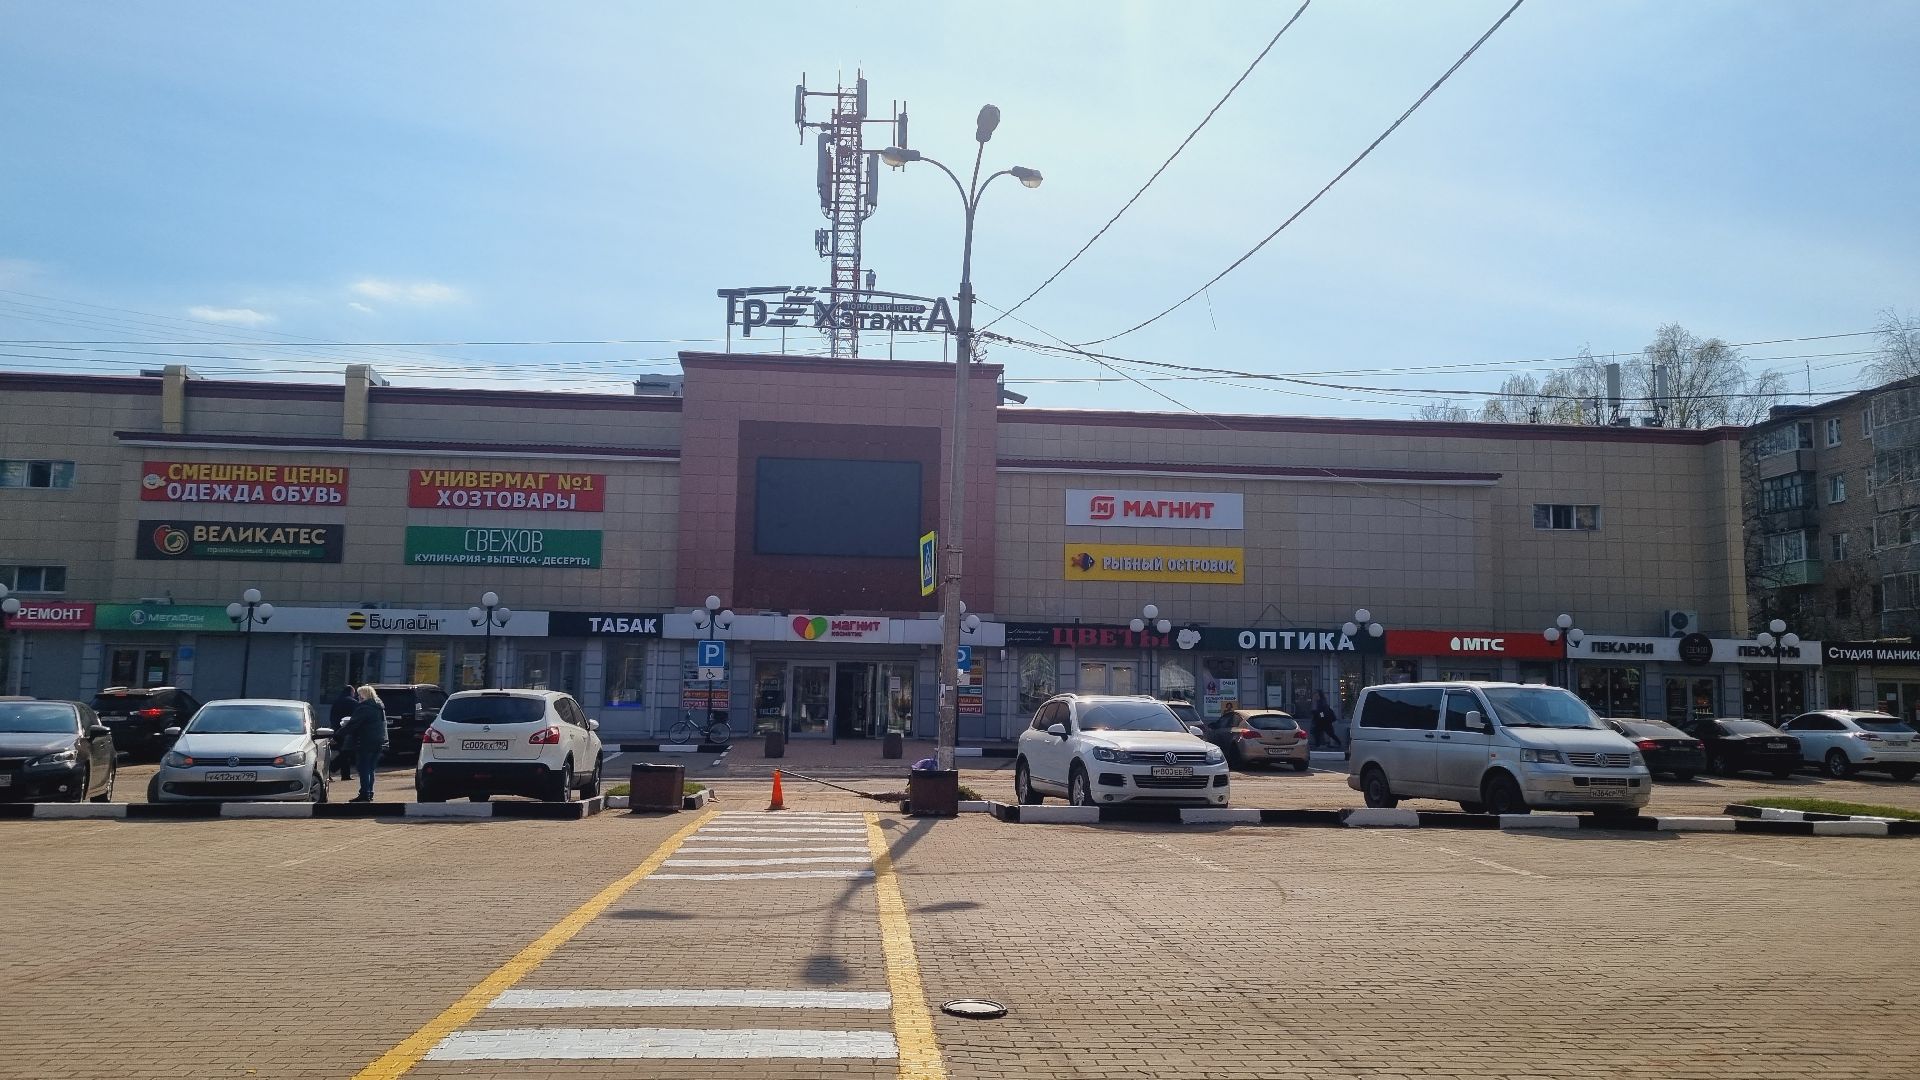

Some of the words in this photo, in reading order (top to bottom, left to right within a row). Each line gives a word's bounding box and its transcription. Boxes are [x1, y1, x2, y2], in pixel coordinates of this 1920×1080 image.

[846, 302, 891, 311] ТОРГОВЫЙ
[893, 304, 921, 313] ЦЕНТР
[168, 463, 278, 483] СМЕШНЫЕ
[281, 466, 345, 486] ЦЕНЫ
[419, 470, 551, 491] УНИВЕРМАГ
[557, 475, 594, 491] №1
[166, 482, 266, 503] ОДЕЖДА
[271, 485, 342, 504] ОБУВЬ
[436, 490, 576, 510] ХОЗТОВАРЫ
[1123, 500, 1215, 520] МАГНИТ
[193, 525, 327, 545] ВЕЛИКАТЕС
[464, 528, 543, 553] СВЕЖОВ
[1103, 555, 1163, 572] РЫБНЫЙ
[1167, 558, 1237, 574] ОСТРОВОК
[16, 607, 84, 620] РЕМОНТ
[368, 612, 440, 631] Билайн
[588, 616, 657, 633] ТАБАК
[1052, 627, 1170, 648] ЦВЕТЫ
[1238, 630, 1355, 651] ОПТИКА
[1463, 637, 1505, 651] МТС
[1591, 641, 1654, 654] ПЕКАРНЯ
